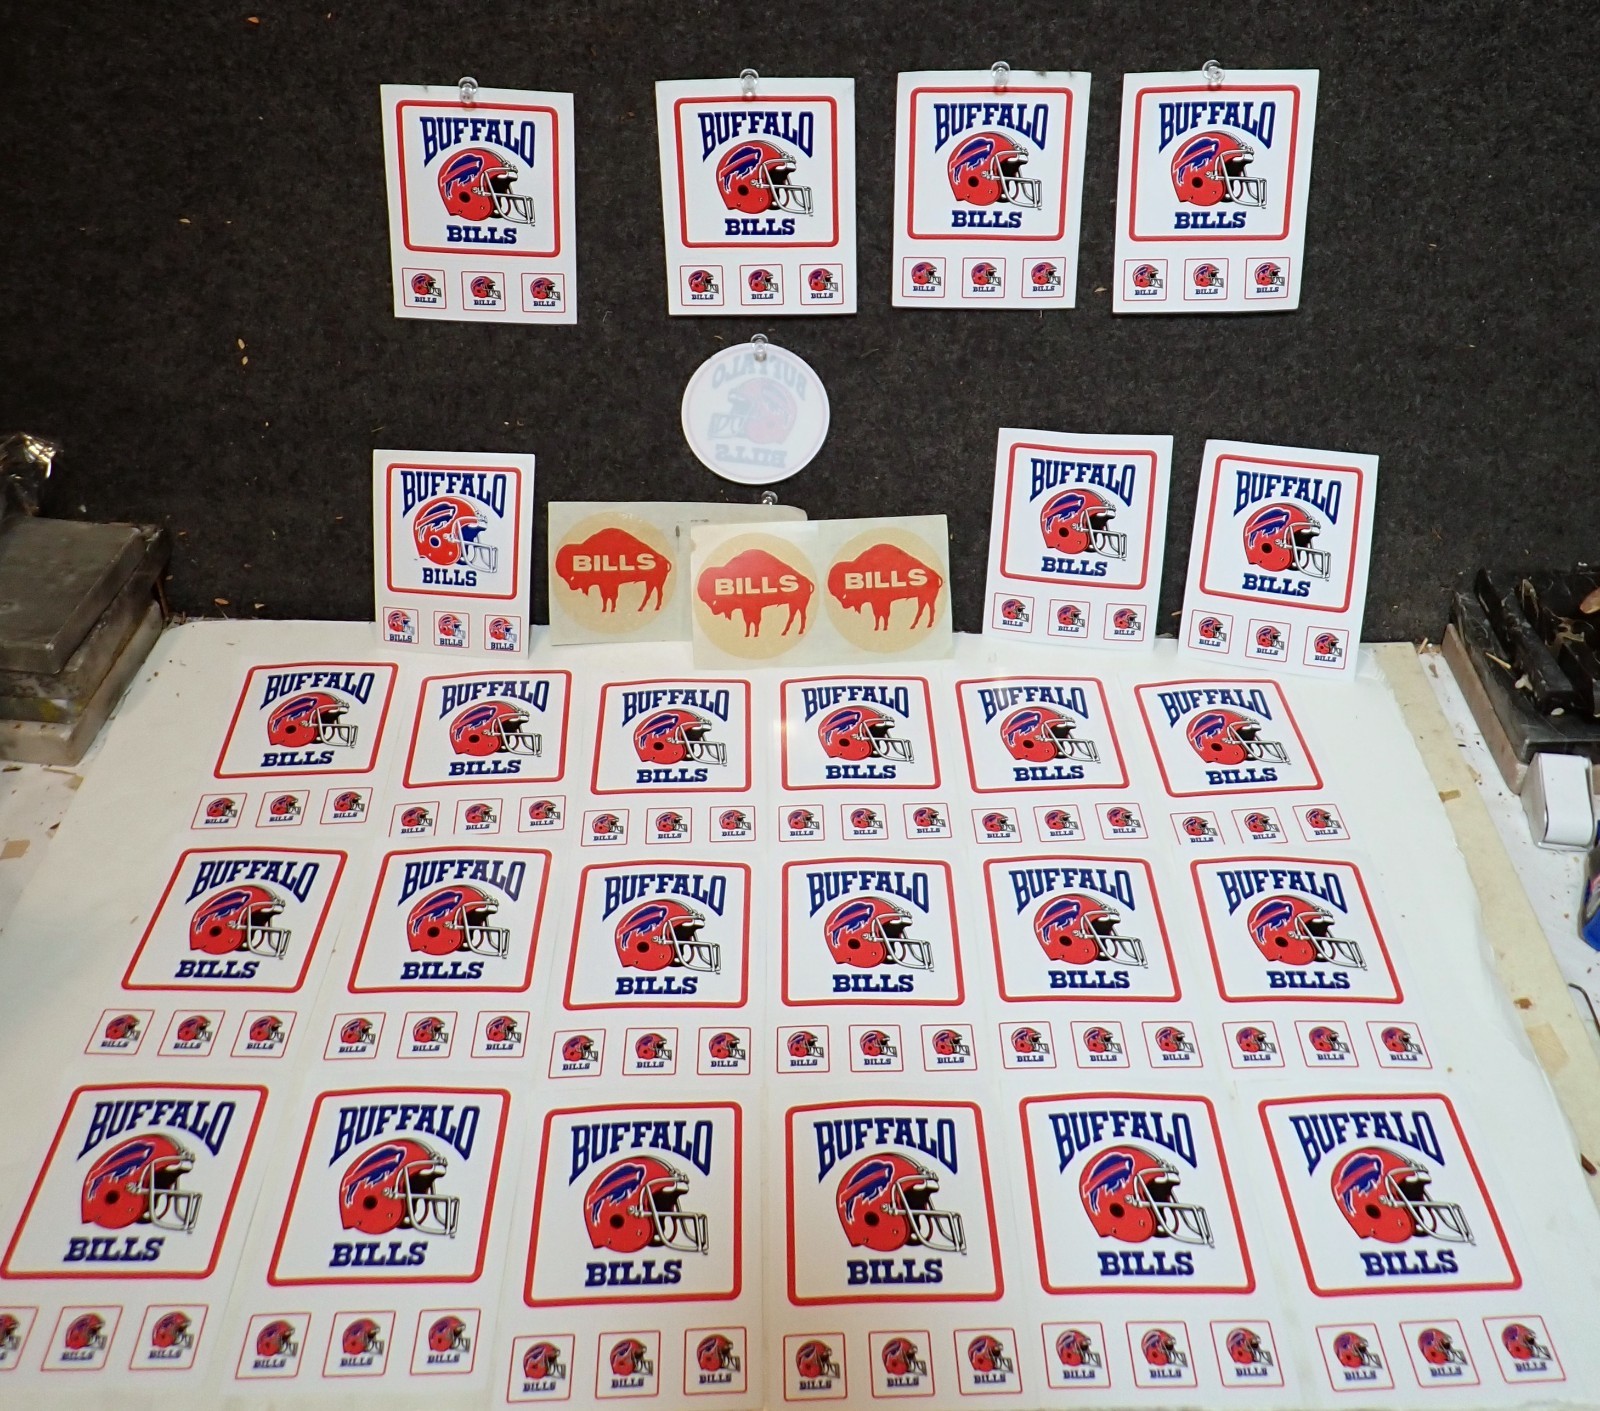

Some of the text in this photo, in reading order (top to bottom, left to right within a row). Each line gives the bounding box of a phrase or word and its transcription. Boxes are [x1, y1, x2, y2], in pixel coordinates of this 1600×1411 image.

[697, 110, 814, 162] BUFFALO
[933, 102, 1049, 154] BUFFALO
[1158, 101, 1276, 154] BUFFALO
[419, 116, 536, 169] BUFFALO
[724, 217, 796, 236] BILLS
[951, 209, 1023, 229] BILLS
[1173, 211, 1247, 230] BILLS
[446, 224, 518, 245] BILLS
[1256, 286, 1280, 294] BILLS
[414, 296, 437, 304] BILLS
[473, 298, 497, 306] BILLS
[1029, 457, 1136, 508] BUFFALO
[400, 470, 507, 519] BUFFALO
[1233, 469, 1342, 526] BUFFALO
[573, 554, 656, 571] BILLS
[1040, 556, 1108, 577] BILLS
[421, 566, 478, 587] BILLS
[715, 575, 799, 595] BILLS
[844, 568, 928, 589] BILLS
[1240, 571, 1312, 598] BILLS
[1002, 619, 1024, 627] BILLS
[1057, 625, 1080, 633] BILLS
[389, 633, 413, 644] BILLS
[439, 637, 463, 647] BILLS
[490, 641, 514, 651] BILLS
[1198, 638, 1221, 647] BILLS
[1256, 647, 1279, 656] BILLS
[1314, 654, 1337, 663] BILLS
[260, 672, 375, 709] BUFFALO
[439, 680, 550, 720] BUFFALO
[621, 689, 730, 728] BUFFALO
[801, 685, 910, 722] BUFFALO
[977, 686, 1089, 725] BUFFALO
[1157, 688, 1273, 729] BUFFALO
[260, 751, 334, 768] BILLS
[448, 759, 522, 777] BILLS
[636, 767, 709, 784] BILLS
[825, 764, 897, 780] BILLS
[1012, 765, 1085, 782] BILLS
[1205, 767, 1278, 786] BILLS
[204, 817, 230, 825] BILLS
[268, 815, 294, 823] BILLS
[464, 823, 490, 831] BILLS
[529, 819, 555, 827] BILLS
[657, 832, 683, 840] BILLS
[1049, 829, 1074, 837] BILLS
[1314, 828, 1339, 836] BILLS
[186, 860, 319, 904] BUFFALO
[397, 859, 526, 907] BUFFALO
[1008, 867, 1136, 916] BUFFALO
[601, 873, 727, 922] BUFFALO
[805, 870, 930, 919] BUFFALO
[1216, 869, 1349, 916] BUFFALO
[174, 960, 259, 980] BILLS
[399, 961, 485, 980] BILLS
[1047, 970, 1131, 989] BILLS
[614, 976, 699, 996] BILLS
[832, 973, 914, 993] BILLS
[1266, 970, 1351, 990] BILLS
[100, 1040, 130, 1049] BILLS
[173, 1041, 203, 1050] BILLS
[245, 1042, 275, 1051] BILLS
[338, 1045, 367, 1053] BILLS
[411, 1044, 441, 1052] BILLS
[485, 1043, 514, 1051] BILLS
[635, 1060, 665, 1069] BILLS
[710, 1060, 739, 1068] BILLS
[789, 1059, 818, 1067] BILLS
[863, 1058, 892, 1066] BILLS
[936, 1056, 965, 1064] BILLS
[1016, 1054, 1045, 1063] BILLS
[1089, 1054, 1118, 1062] BILLS
[1162, 1053, 1191, 1061] BILLS
[1242, 1053, 1272, 1062] BILLS
[1317, 1052, 1345, 1061] BILLS
[1390, 1053, 1418, 1062] BILLS
[561, 1062, 591, 1071] BILLS
[76, 1101, 235, 1161] BUFFALO
[328, 1104, 481, 1168] BUFFALO
[812, 1117, 958, 1182] BUFFALO
[1048, 1110, 1198, 1175] BUFFALO
[1288, 1111, 1446, 1177] BUFFALO
[568, 1121, 714, 1187] BUFFALO
[62, 1238, 164, 1263] BILLS
[328, 1242, 428, 1268] BILLS
[1097, 1250, 1195, 1277] BILLS
[1359, 1249, 1459, 1277] BILLS
[584, 1262, 681, 1288] BILLS
[847, 1261, 943, 1286] BILLS
